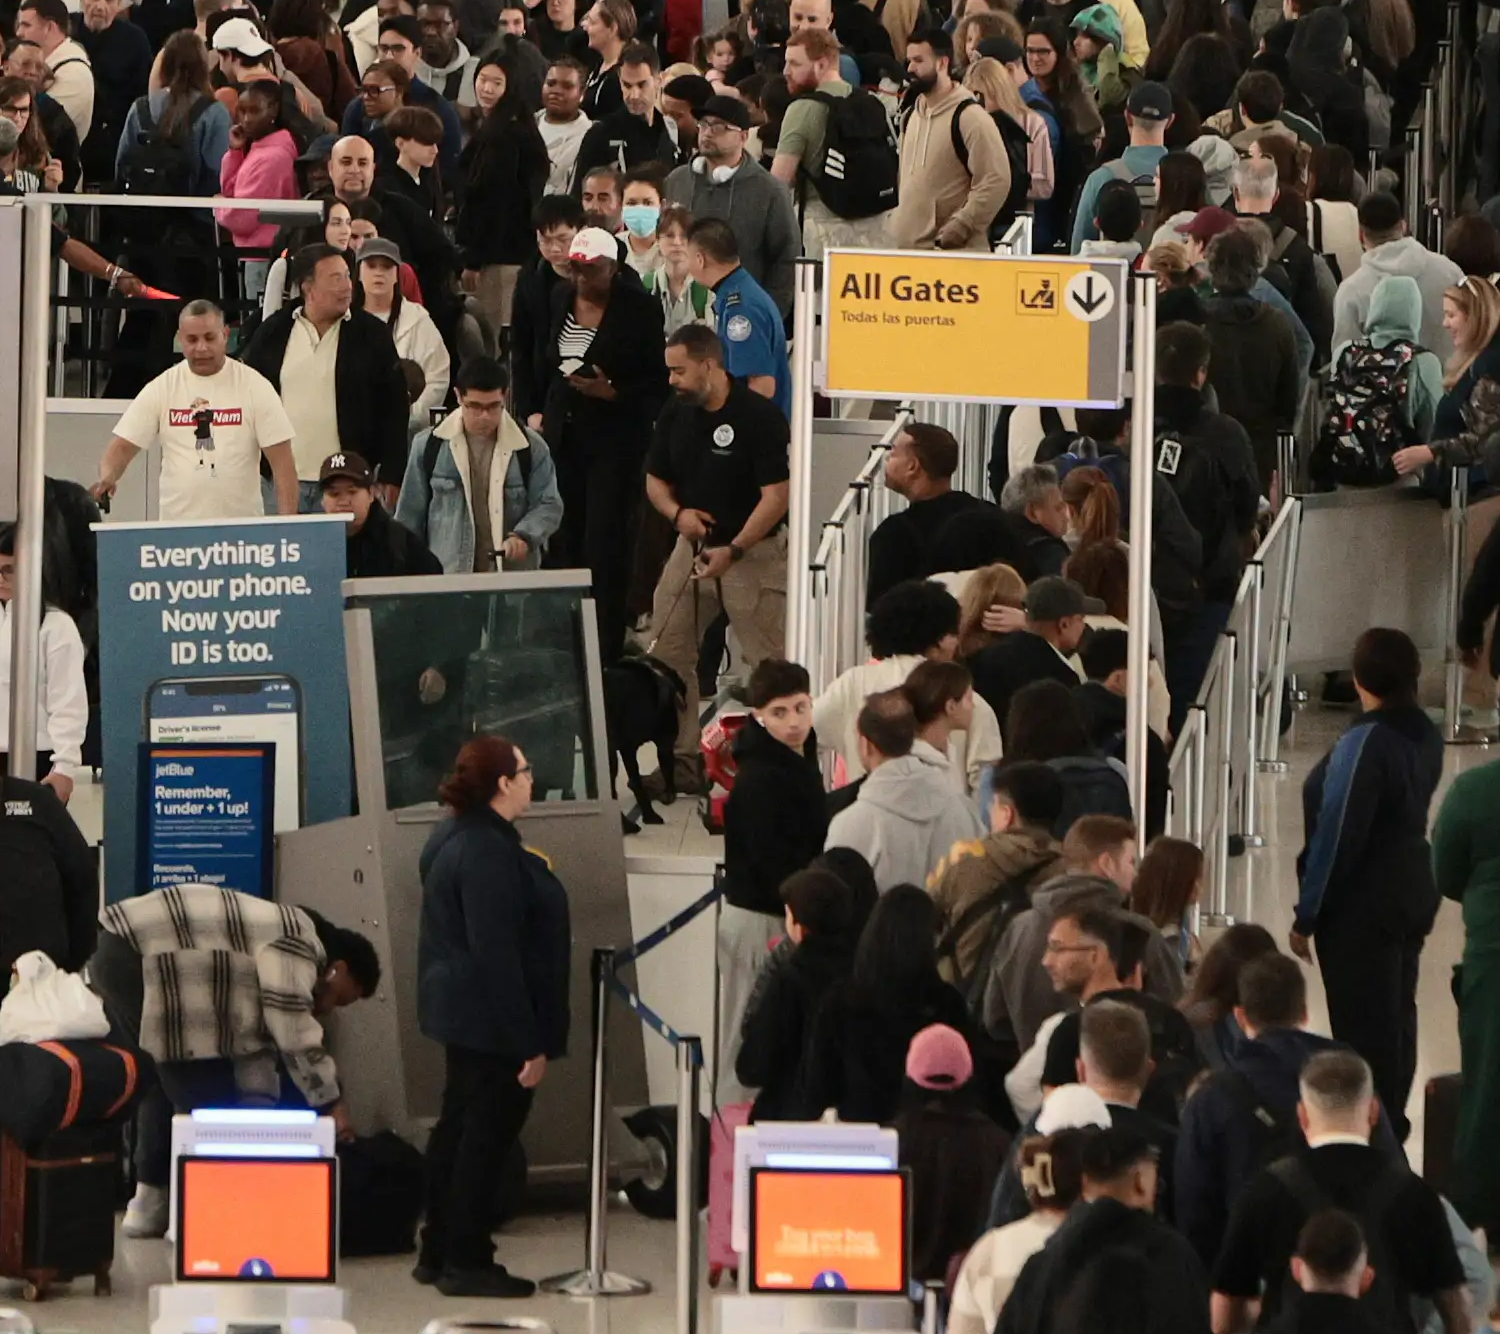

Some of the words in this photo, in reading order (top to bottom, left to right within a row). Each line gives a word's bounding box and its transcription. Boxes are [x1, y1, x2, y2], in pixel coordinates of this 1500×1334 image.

[840, 272, 881, 302] All
[890, 274, 980, 305] Gates
[840, 311, 879, 324] Todas
[882, 312, 901, 325] las
[904, 314, 956, 328] puertas
[170, 411, 195, 424] Viet
[213, 411, 241, 423] Nam
[140, 539, 277, 570] Everything
[280, 538, 301, 564] is
[129, 583, 160, 602] on
[165, 577, 225, 605] your
[228, 573, 312, 602] phone.
[161, 608, 218, 634] Now
[222, 605, 281, 635] your
[171, 641, 196, 666] ID
[202, 640, 222, 665] is
[226, 640, 274, 664] too.
[154, 785, 232, 801] Remember,
[154, 801, 163, 815] 1
[164, 801, 205, 815] under
[227, 801, 249, 817] up!
